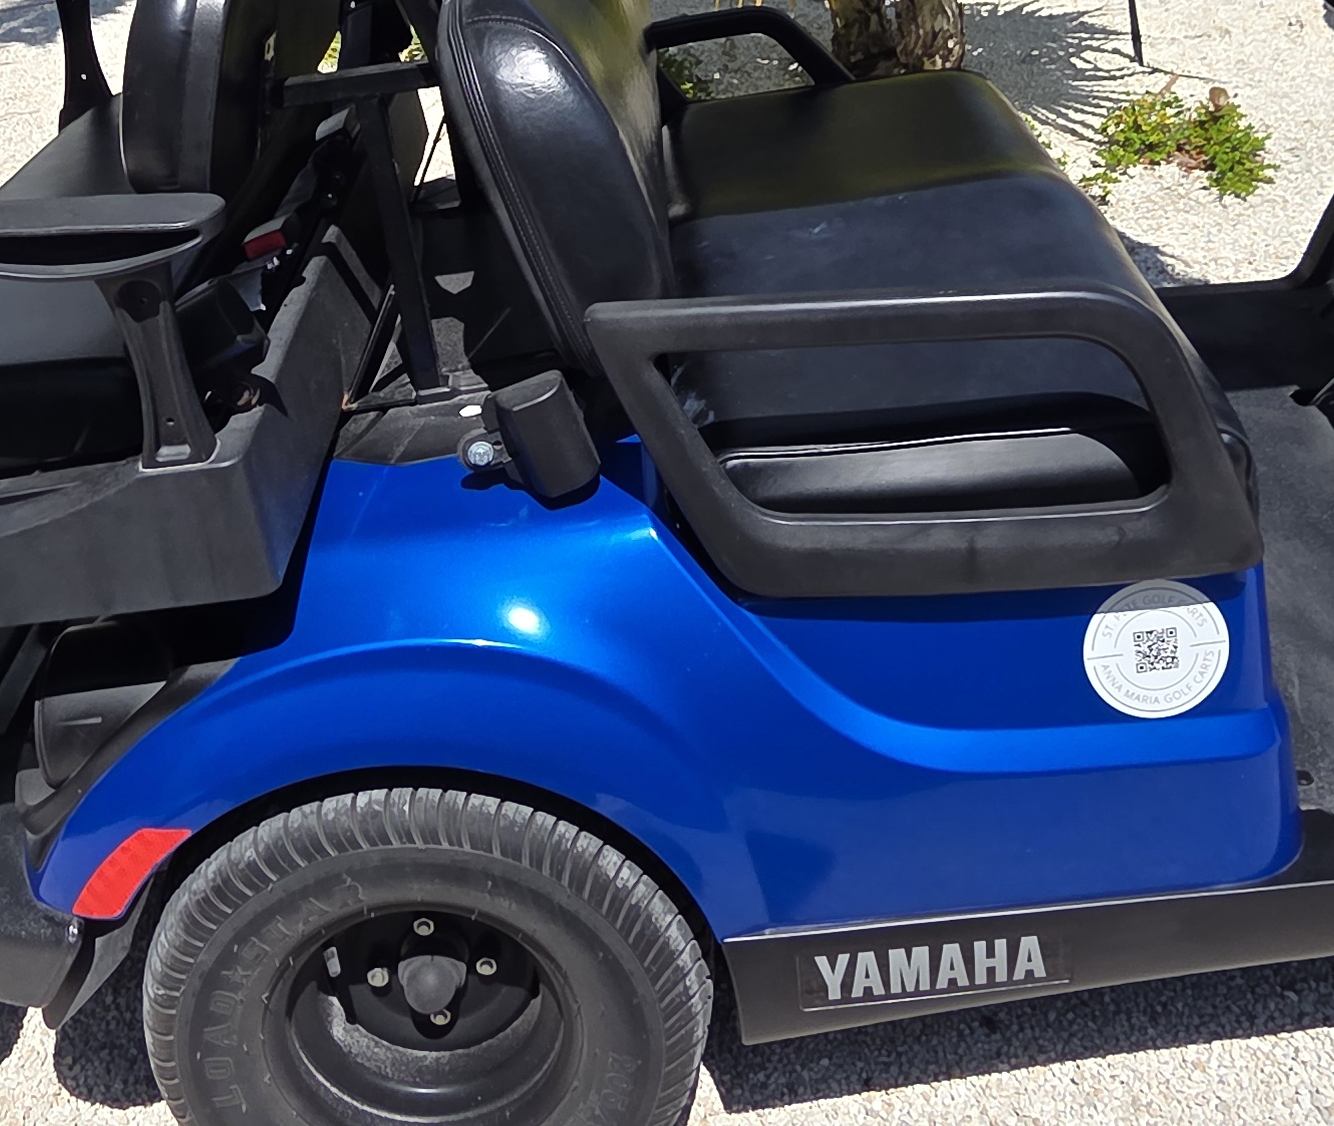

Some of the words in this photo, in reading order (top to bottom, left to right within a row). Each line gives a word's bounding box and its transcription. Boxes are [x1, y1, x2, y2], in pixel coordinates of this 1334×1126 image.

[1142, 594, 1176, 606] GOLF
[1101, 664, 1123, 693] ANNA
[1123, 689, 1161, 705] MARIA
[1163, 682, 1194, 704] GOLF
[1193, 650, 1215, 684] CARTS
[813, 935, 1047, 1001] YAMAHA
